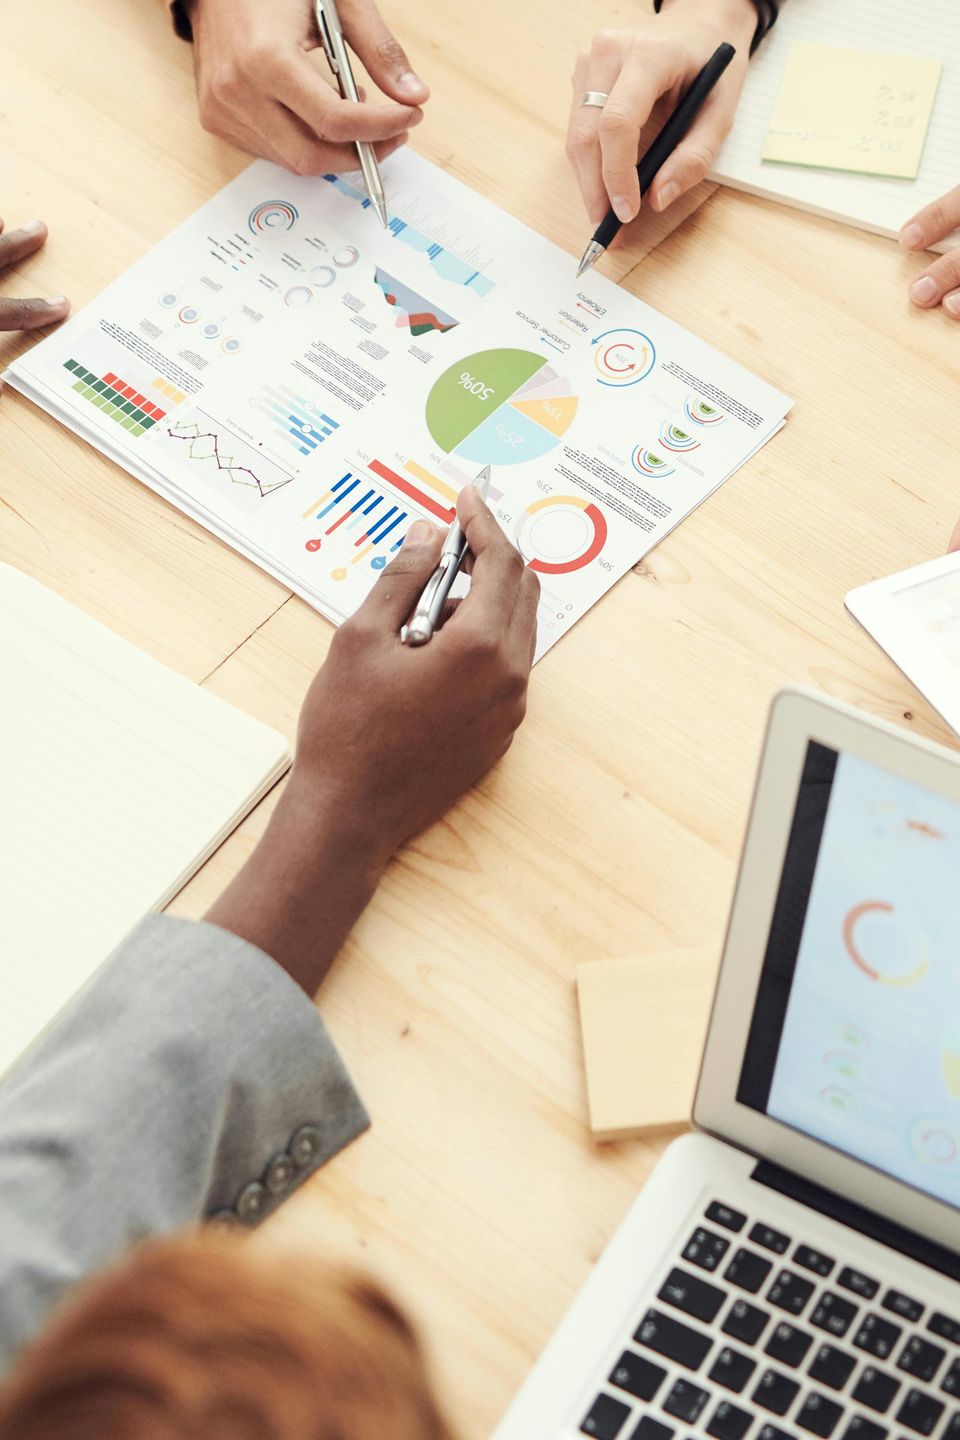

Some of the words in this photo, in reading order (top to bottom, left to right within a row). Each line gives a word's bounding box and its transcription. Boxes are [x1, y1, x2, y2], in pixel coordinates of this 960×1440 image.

[577, 292, 607, 316] Efficiency
[516, 311, 539, 329] Service
[558, 310, 589, 333] Retention
[539, 327, 571, 350] Customer
[458, 372, 494, 400] 50%
[542, 401, 562, 419] 15%
[494, 423, 525, 448] 25%
[536, 480, 552, 494] 25%
[497, 509, 512, 523] 15%
[598, 557, 614, 572] 50%
